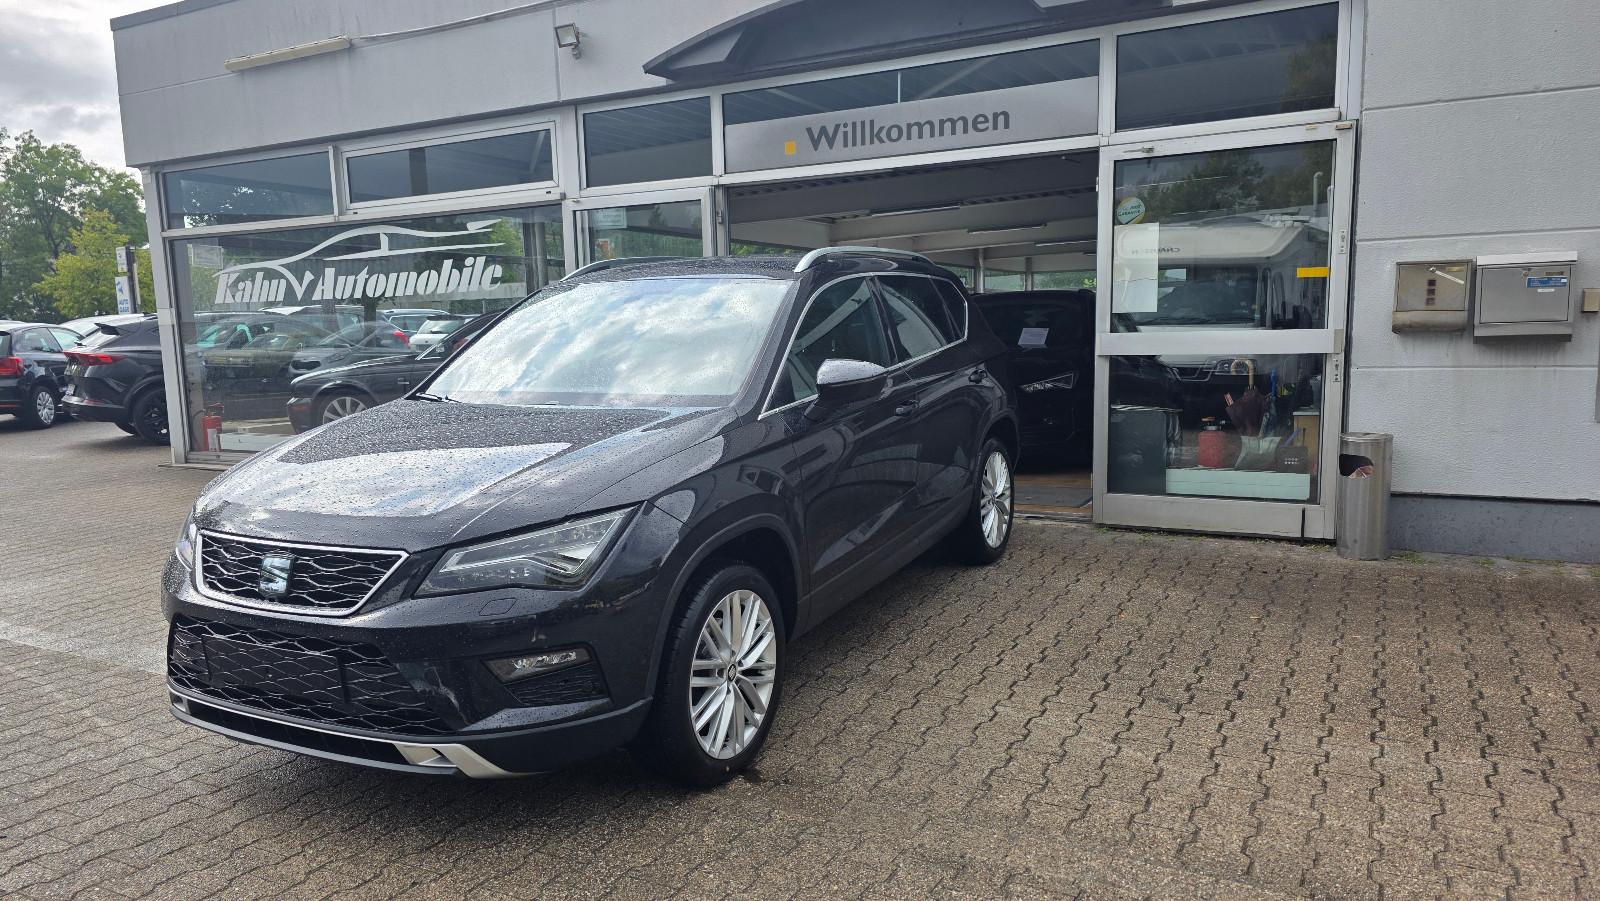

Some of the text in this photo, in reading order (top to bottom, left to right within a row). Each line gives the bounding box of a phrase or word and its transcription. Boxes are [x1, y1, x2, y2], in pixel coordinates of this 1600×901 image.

[806, 110, 1010, 151] Willkommen
[214, 256, 502, 304] Kahn Automobile
